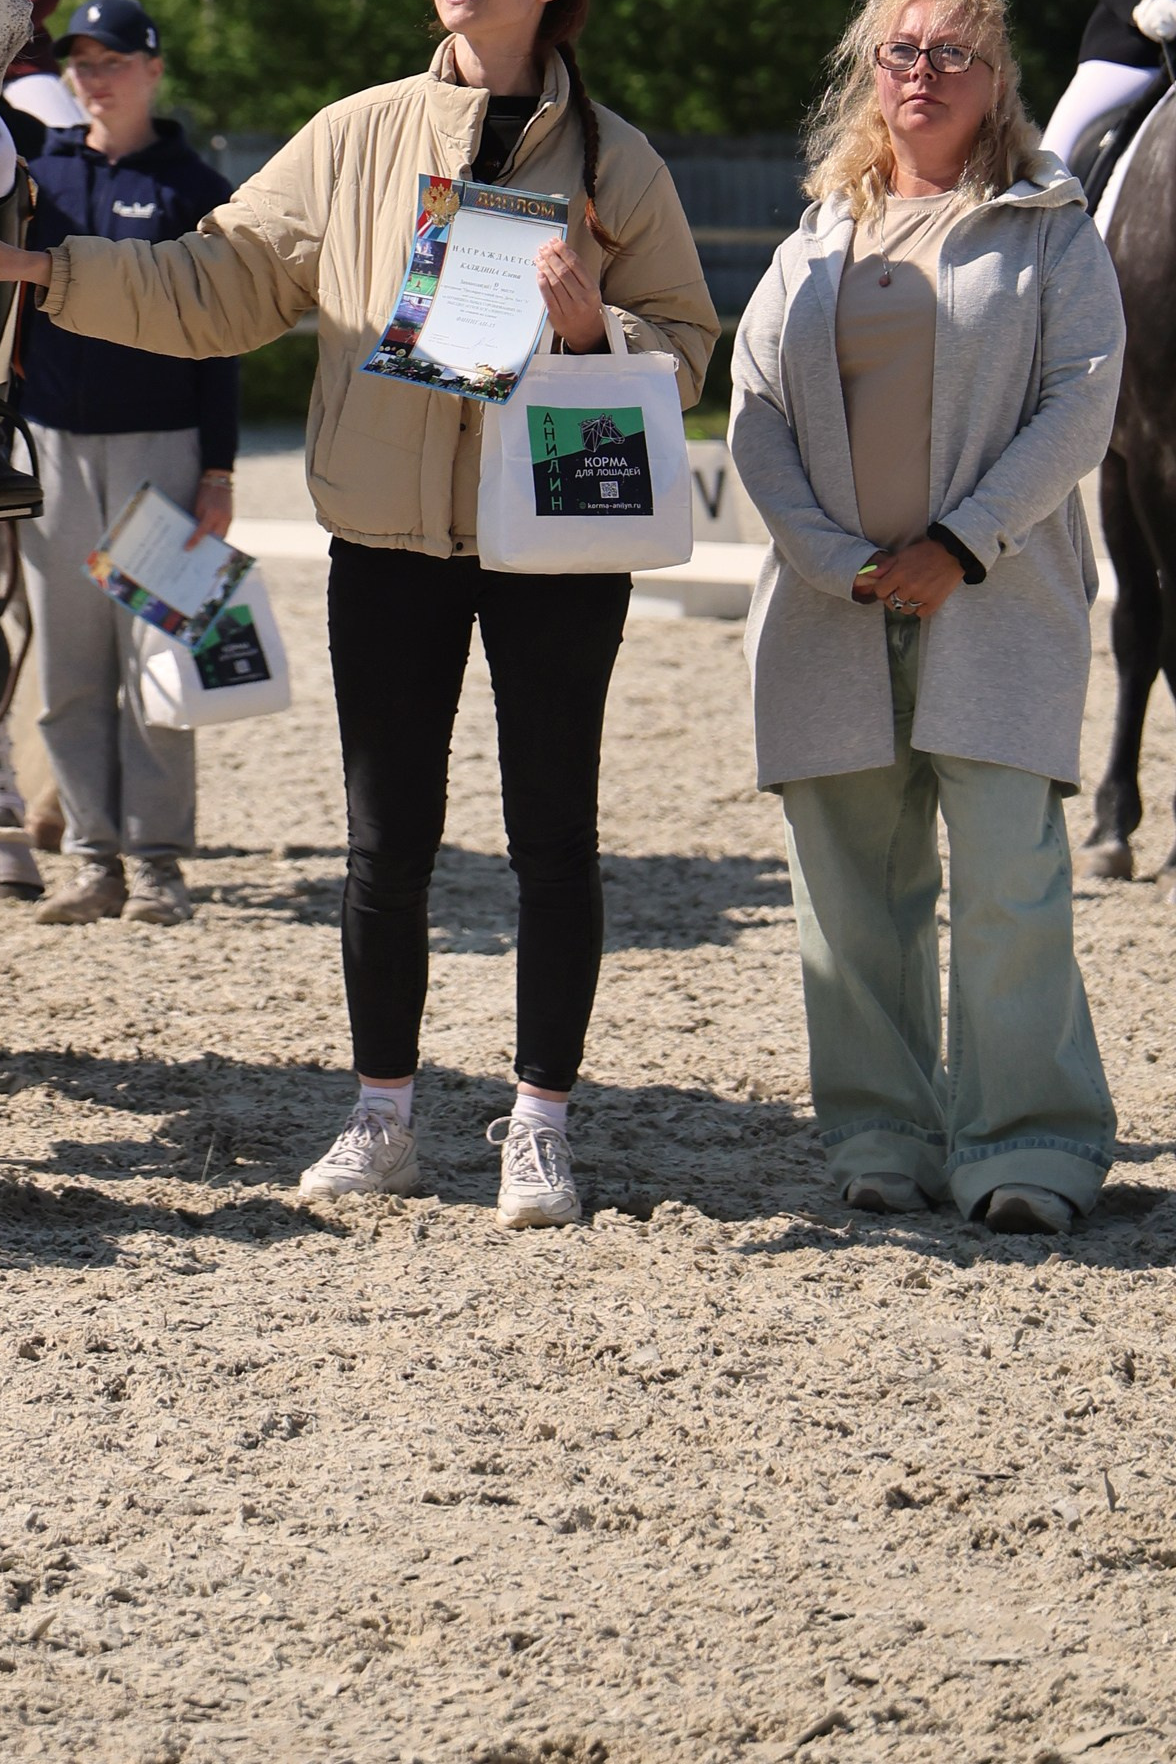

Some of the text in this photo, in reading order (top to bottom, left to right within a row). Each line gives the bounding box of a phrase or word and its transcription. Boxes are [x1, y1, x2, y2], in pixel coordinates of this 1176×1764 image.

[475, 191, 555, 218] ДИПЛОМ
[452, 244, 537, 267] НАГРАЖДАЕТСЯ
[543, 412, 563, 511] АНИЛИН
[575, 467, 641, 478] ДЛЯ ЛОШАДЕЙ
[584, 457, 628, 467] КОРМА
[693, 467, 725, 520] V
[587, 502, 641, 510] korma-anilyn.ru
